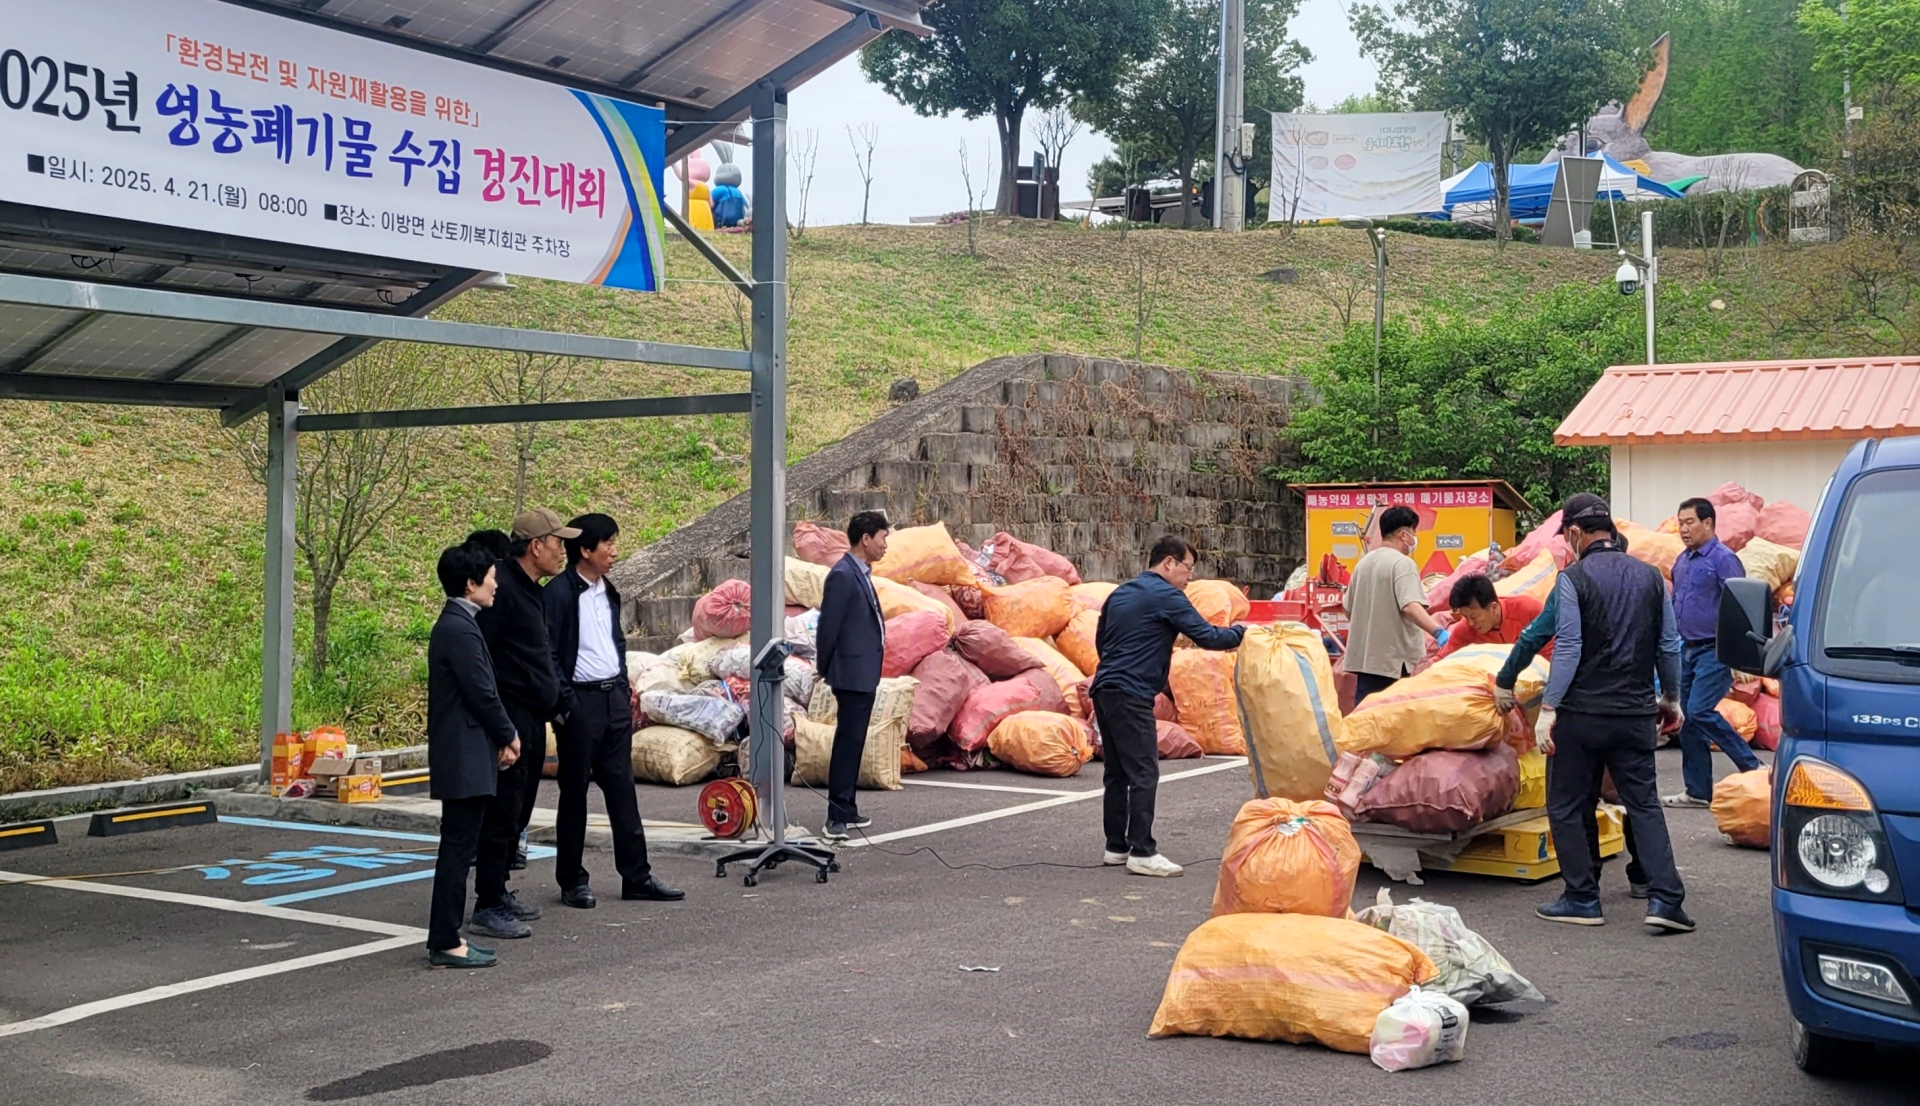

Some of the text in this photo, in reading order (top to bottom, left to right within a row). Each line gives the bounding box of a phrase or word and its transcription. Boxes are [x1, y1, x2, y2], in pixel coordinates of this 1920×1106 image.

[278, 59, 298, 89] 및
[307, 66, 426, 116] 자원재활용을
[155, 82, 378, 178] 영농폐기물
[388, 129, 461, 195] 수집
[473, 148, 605, 219] 경진대회
[101, 165, 157, 193] 2025.
[164, 177, 181, 197] 4.
[188, 180, 248, 209] 21.(월)
[258, 192, 308, 217] 08:00
[381, 211, 425, 236] 이방면
[430, 219, 527, 252] 산토끼복지회관
[531, 235, 571, 258] 주차장
[1393, 492, 1415, 505] 유해
[1420, 491, 1490, 506] 폐기물저장소
[1904, 716, 1920, 728] C
